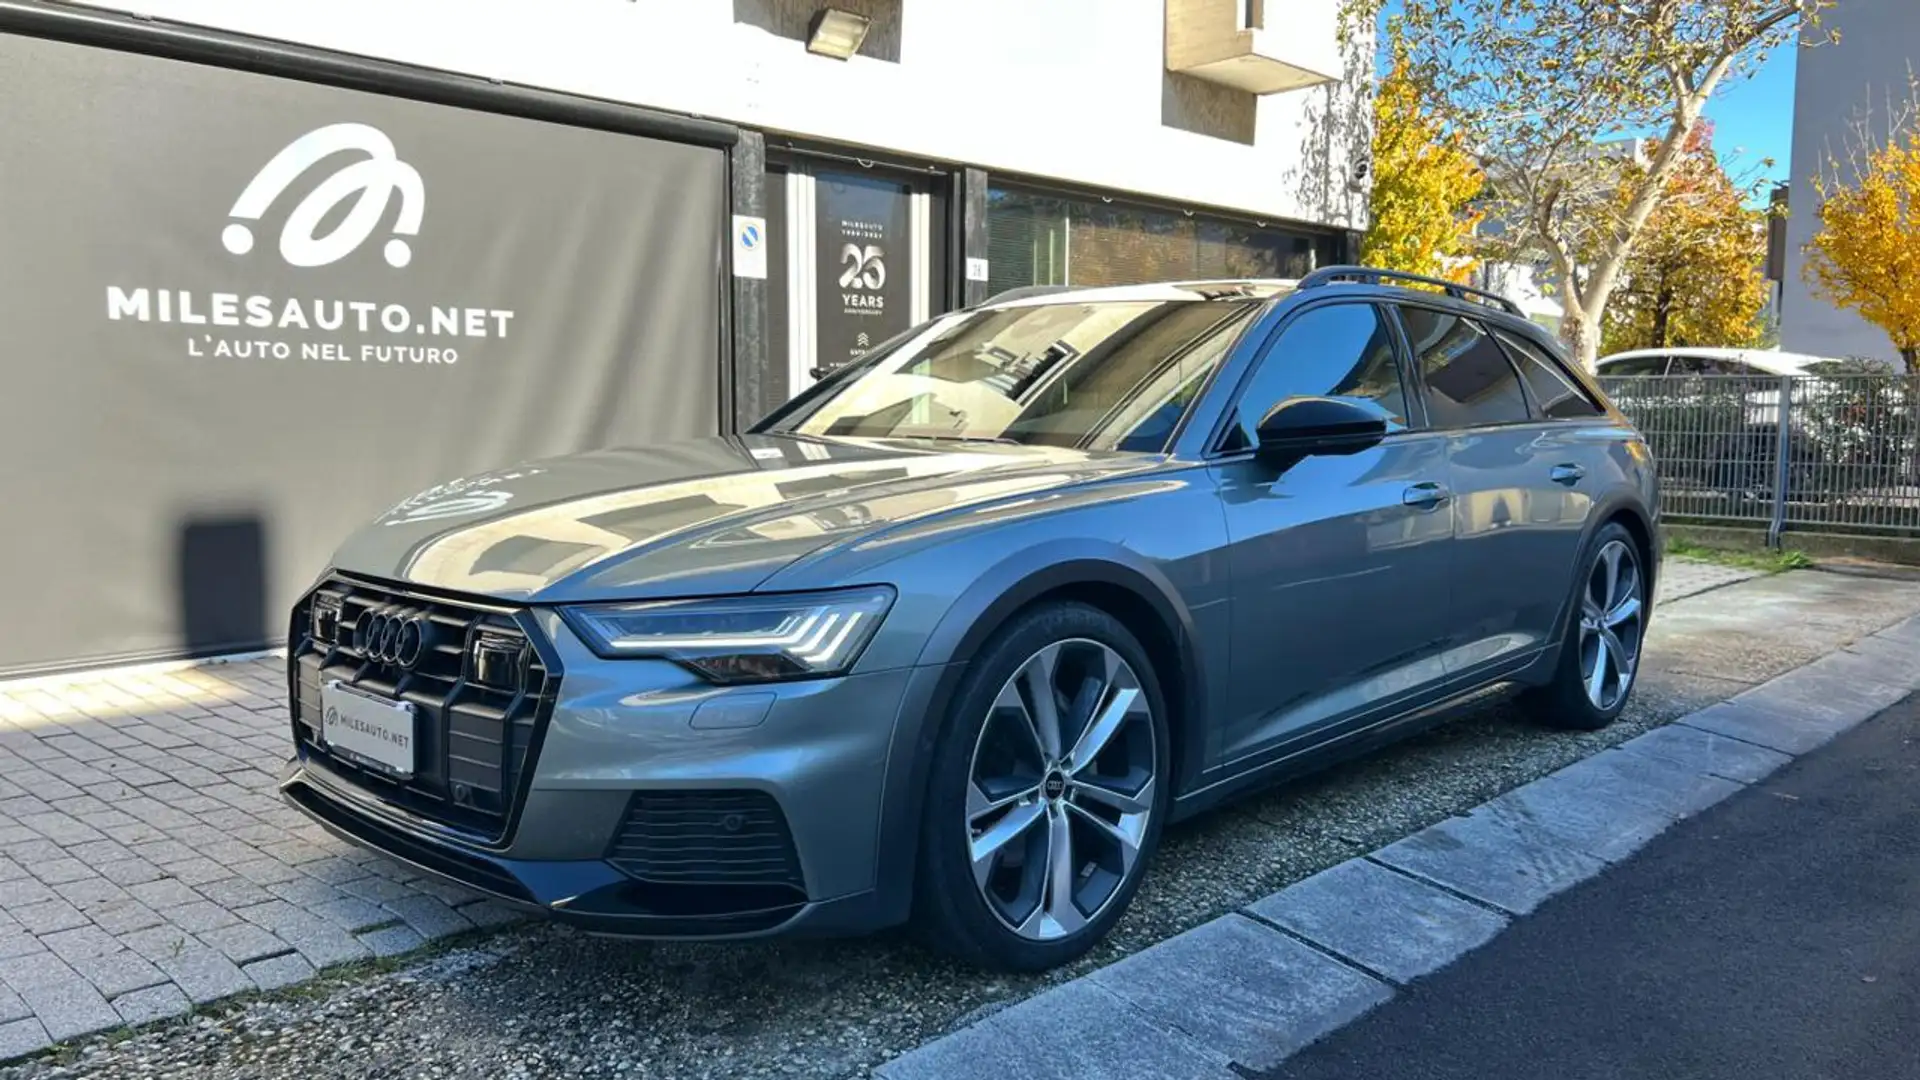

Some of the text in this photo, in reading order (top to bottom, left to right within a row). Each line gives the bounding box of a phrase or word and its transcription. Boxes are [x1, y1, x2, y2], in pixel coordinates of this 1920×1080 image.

[838, 242, 887, 291] 25
[106, 285, 514, 338] MILESAUTO.NET
[841, 293, 884, 308] YEARS
[188, 335, 459, 364] L'AUTO NEL FUTURO
[340, 715, 409, 748] MILESAUTO.NET
